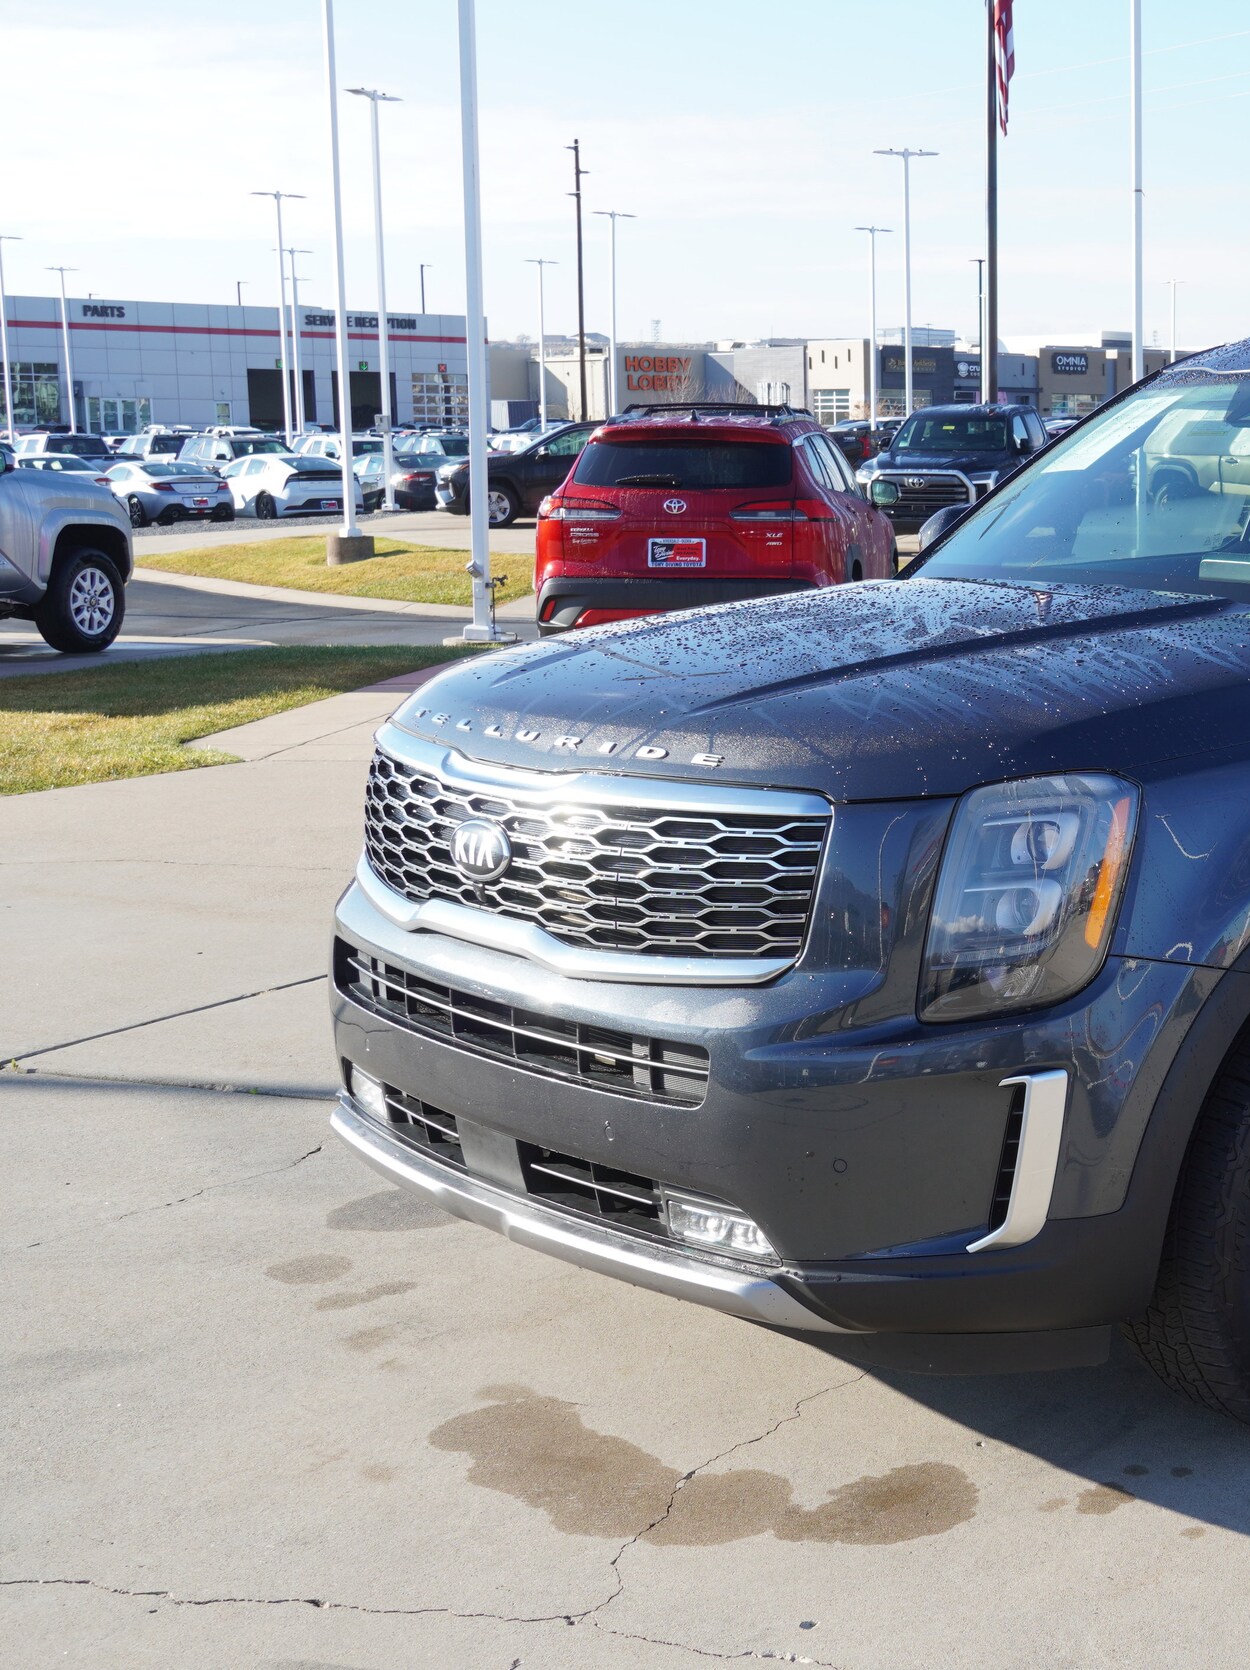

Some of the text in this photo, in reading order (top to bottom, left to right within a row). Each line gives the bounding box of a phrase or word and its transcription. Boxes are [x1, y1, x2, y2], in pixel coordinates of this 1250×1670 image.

[82, 304, 126, 318] PARTS
[304, 314, 417, 330] SERVE RECTION
[625, 355, 692, 373] HOBBY
[1056, 355, 1087, 366] OMNIA
[415, 708, 726, 768] TELLURIDE
[454, 829, 496, 870] KIA
